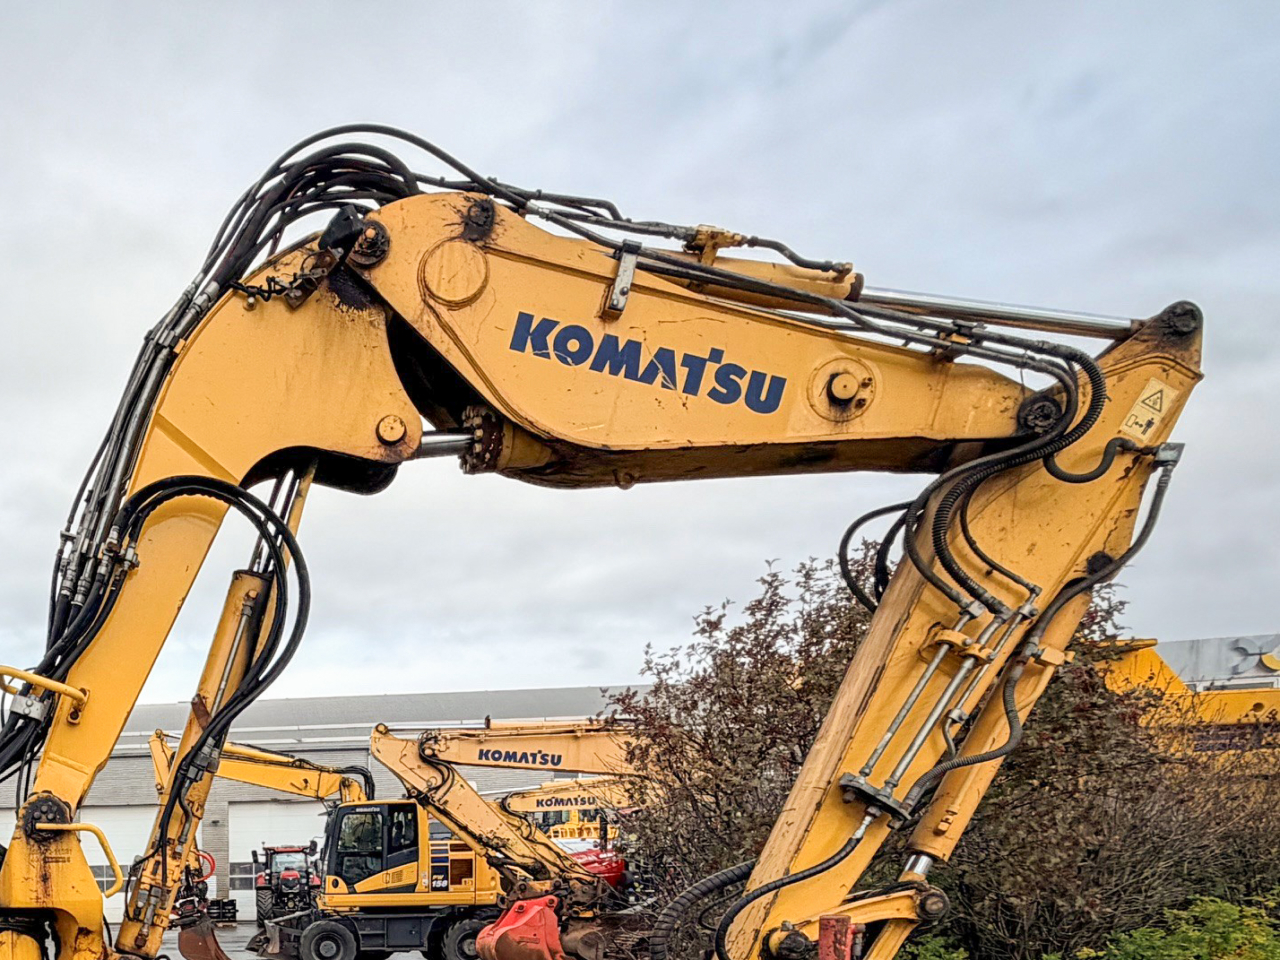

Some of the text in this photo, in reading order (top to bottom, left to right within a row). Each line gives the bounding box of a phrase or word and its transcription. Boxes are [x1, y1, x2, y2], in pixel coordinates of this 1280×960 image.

[509, 310, 788, 415] KOMATSU
[477, 748, 563, 767] KOMATSU
[535, 794, 598, 808] KOMATSU
[431, 880, 448, 888] 158
